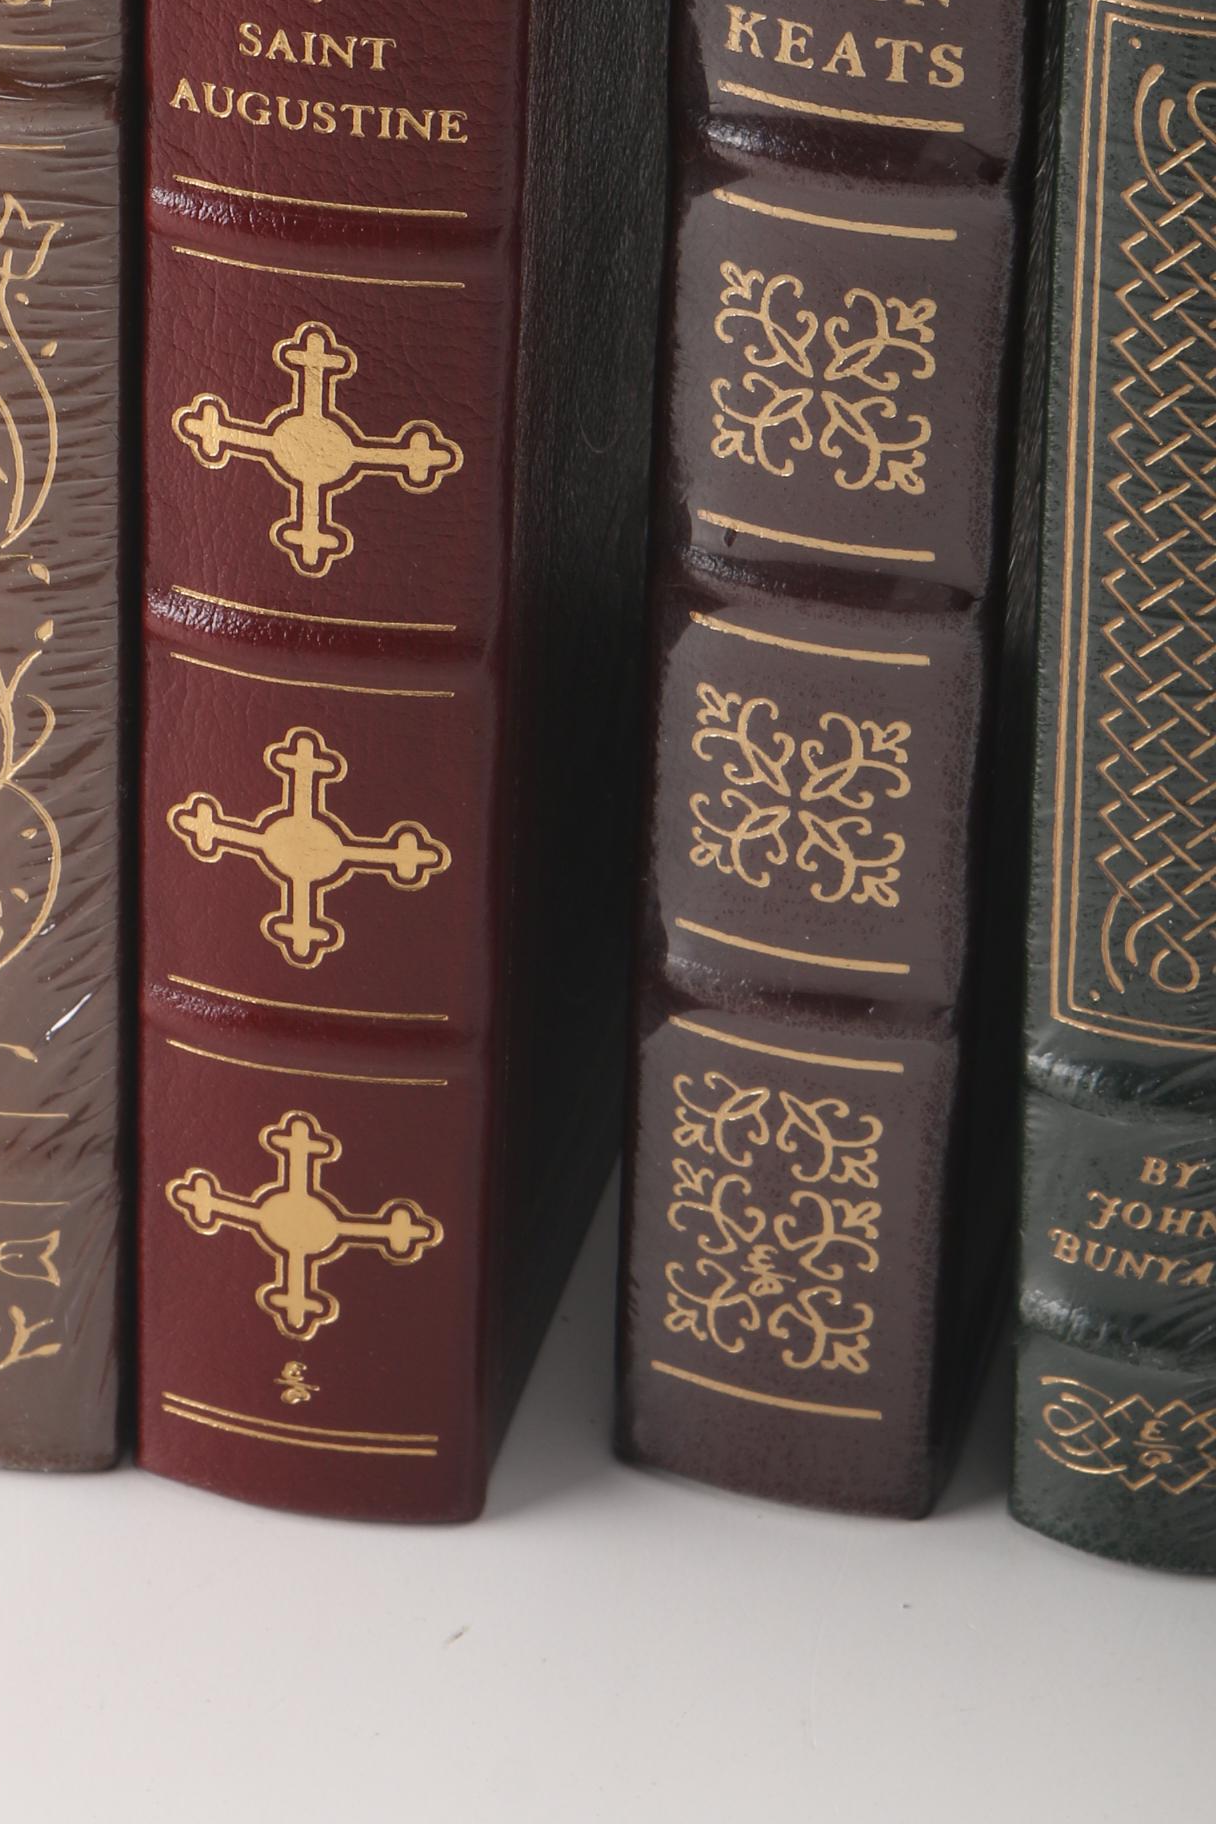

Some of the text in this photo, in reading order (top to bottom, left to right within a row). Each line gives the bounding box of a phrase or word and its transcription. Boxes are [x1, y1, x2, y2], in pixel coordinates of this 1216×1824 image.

[238, 22, 398, 72] SAINT
[723, 3, 966, 89] KEATS
[169, 77, 470, 144] AUGUSTINE
[1139, 1155, 1209, 1189] BY
